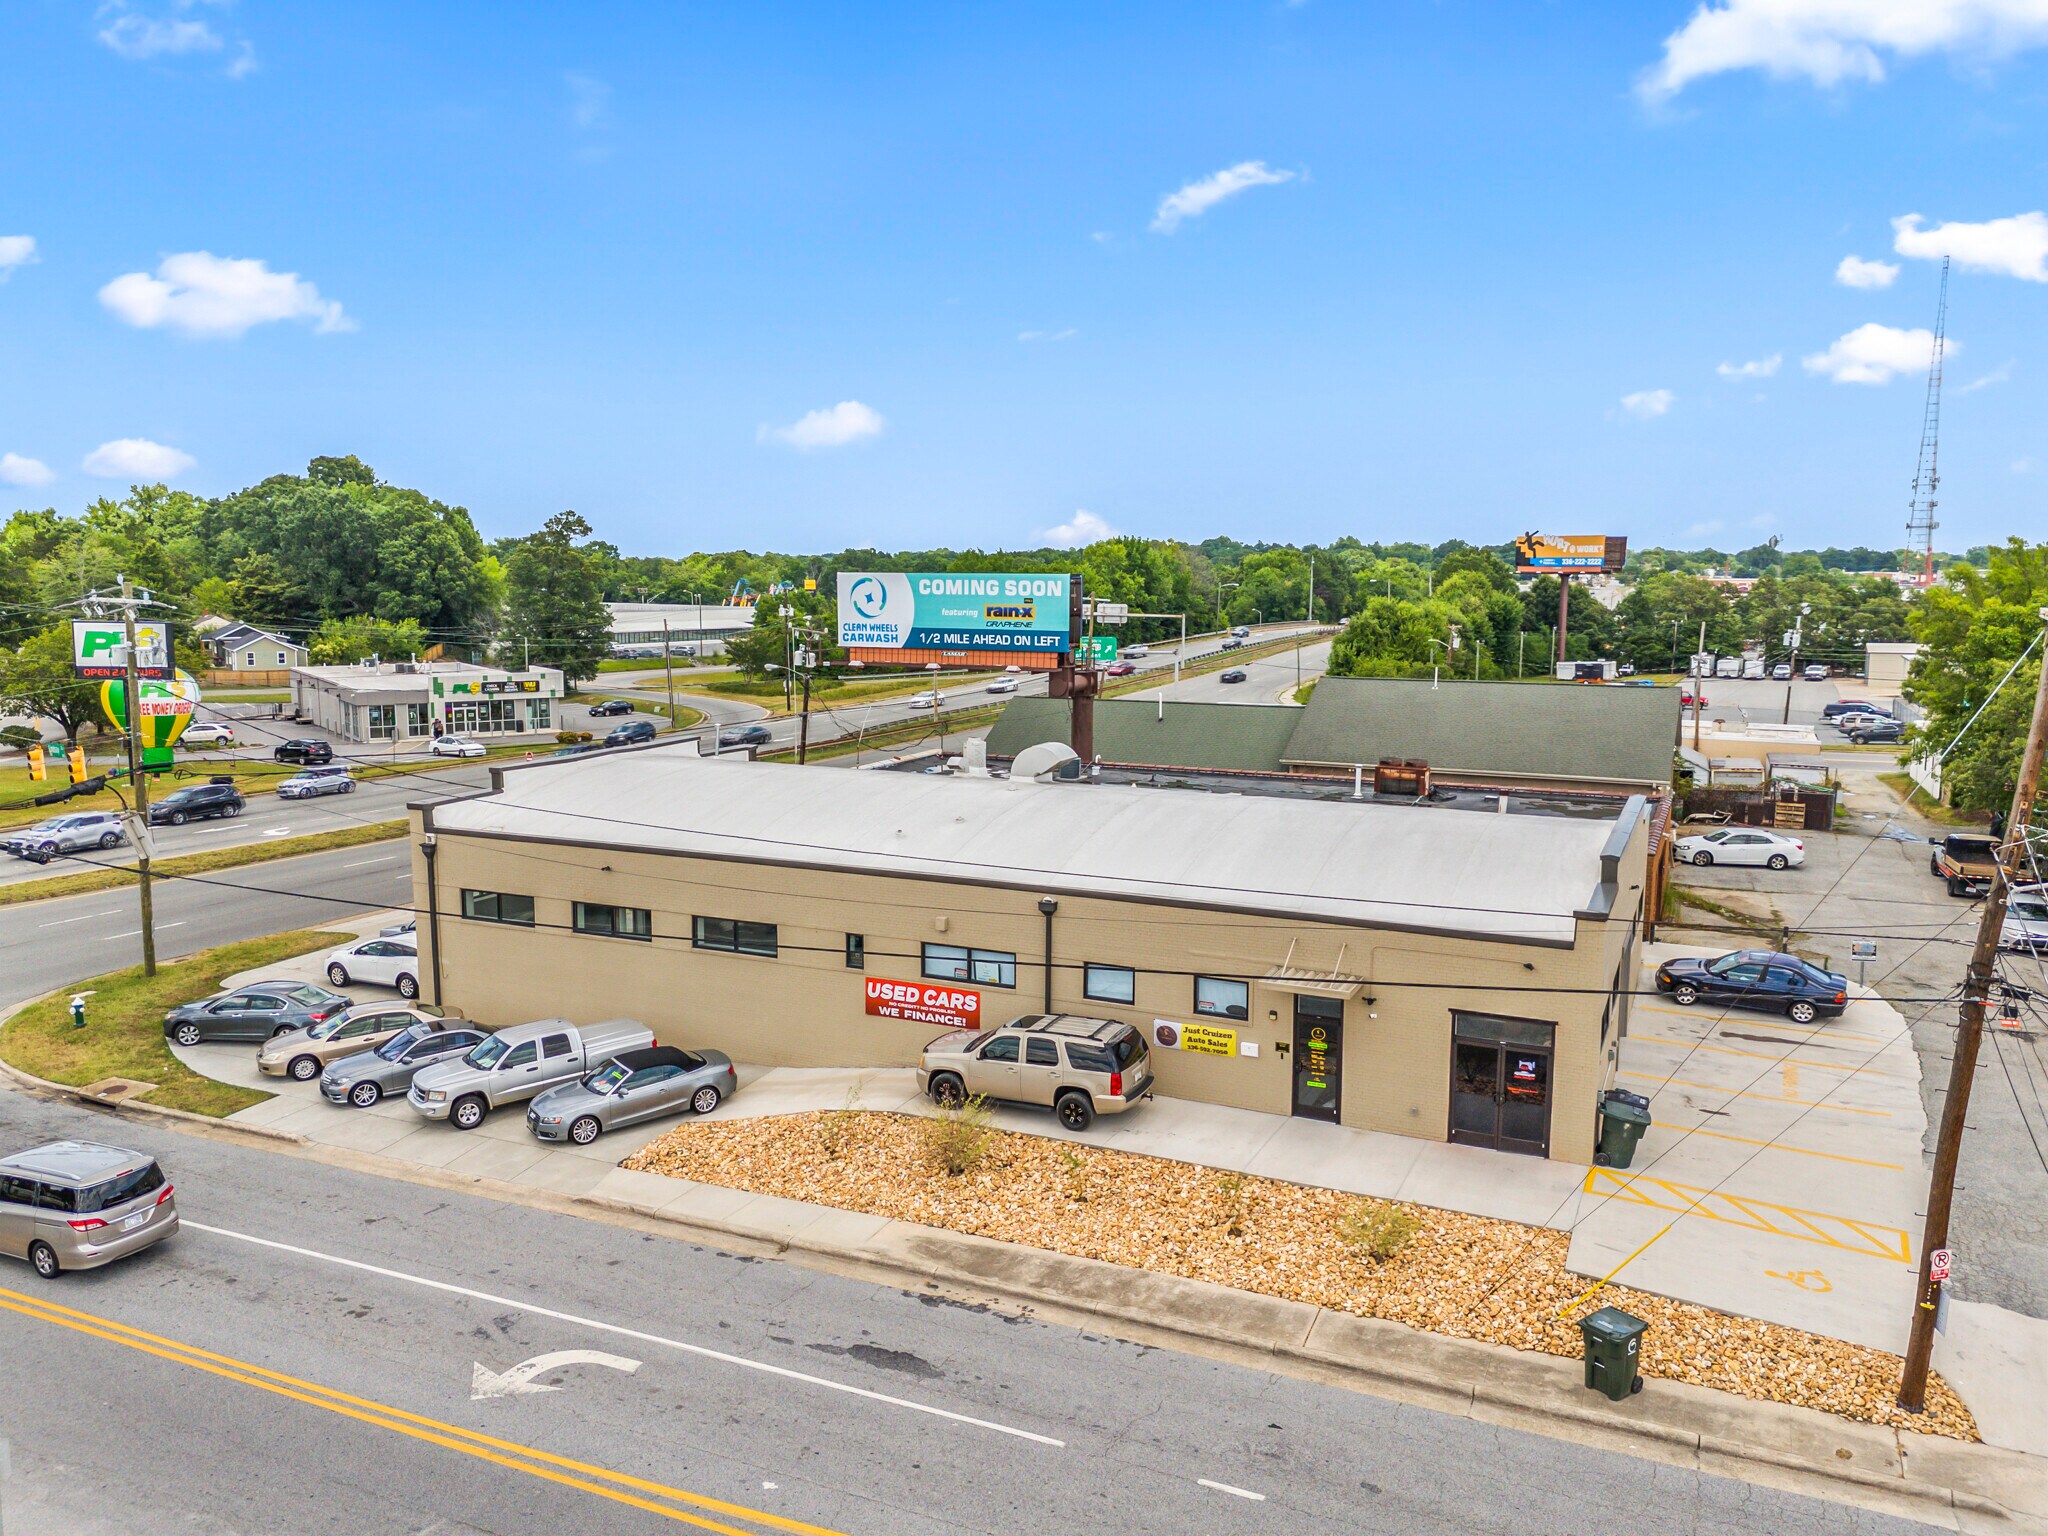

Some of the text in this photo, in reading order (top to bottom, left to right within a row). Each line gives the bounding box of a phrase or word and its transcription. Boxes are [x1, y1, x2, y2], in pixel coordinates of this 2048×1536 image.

[1577, 545, 1603, 553] WORK?
[919, 579, 1062, 597] COMING SOON
[941, 608, 978, 618] featuring
[843, 623, 898, 633] CLEAN WHEELS
[842, 632, 899, 643] CARWASH
[919, 633, 1060, 647] 1/2 MILE AHEAD ON LEFT
[83, 668, 110, 677] OPEN
[151, 702, 174, 715] MONEY
[867, 982, 978, 1012] USED CARS
[878, 1006, 967, 1027] WE FINANCE!
[1183, 1026, 1233, 1039] Just Cruizen
[1187, 1036, 1228, 1048] Auto Sales
